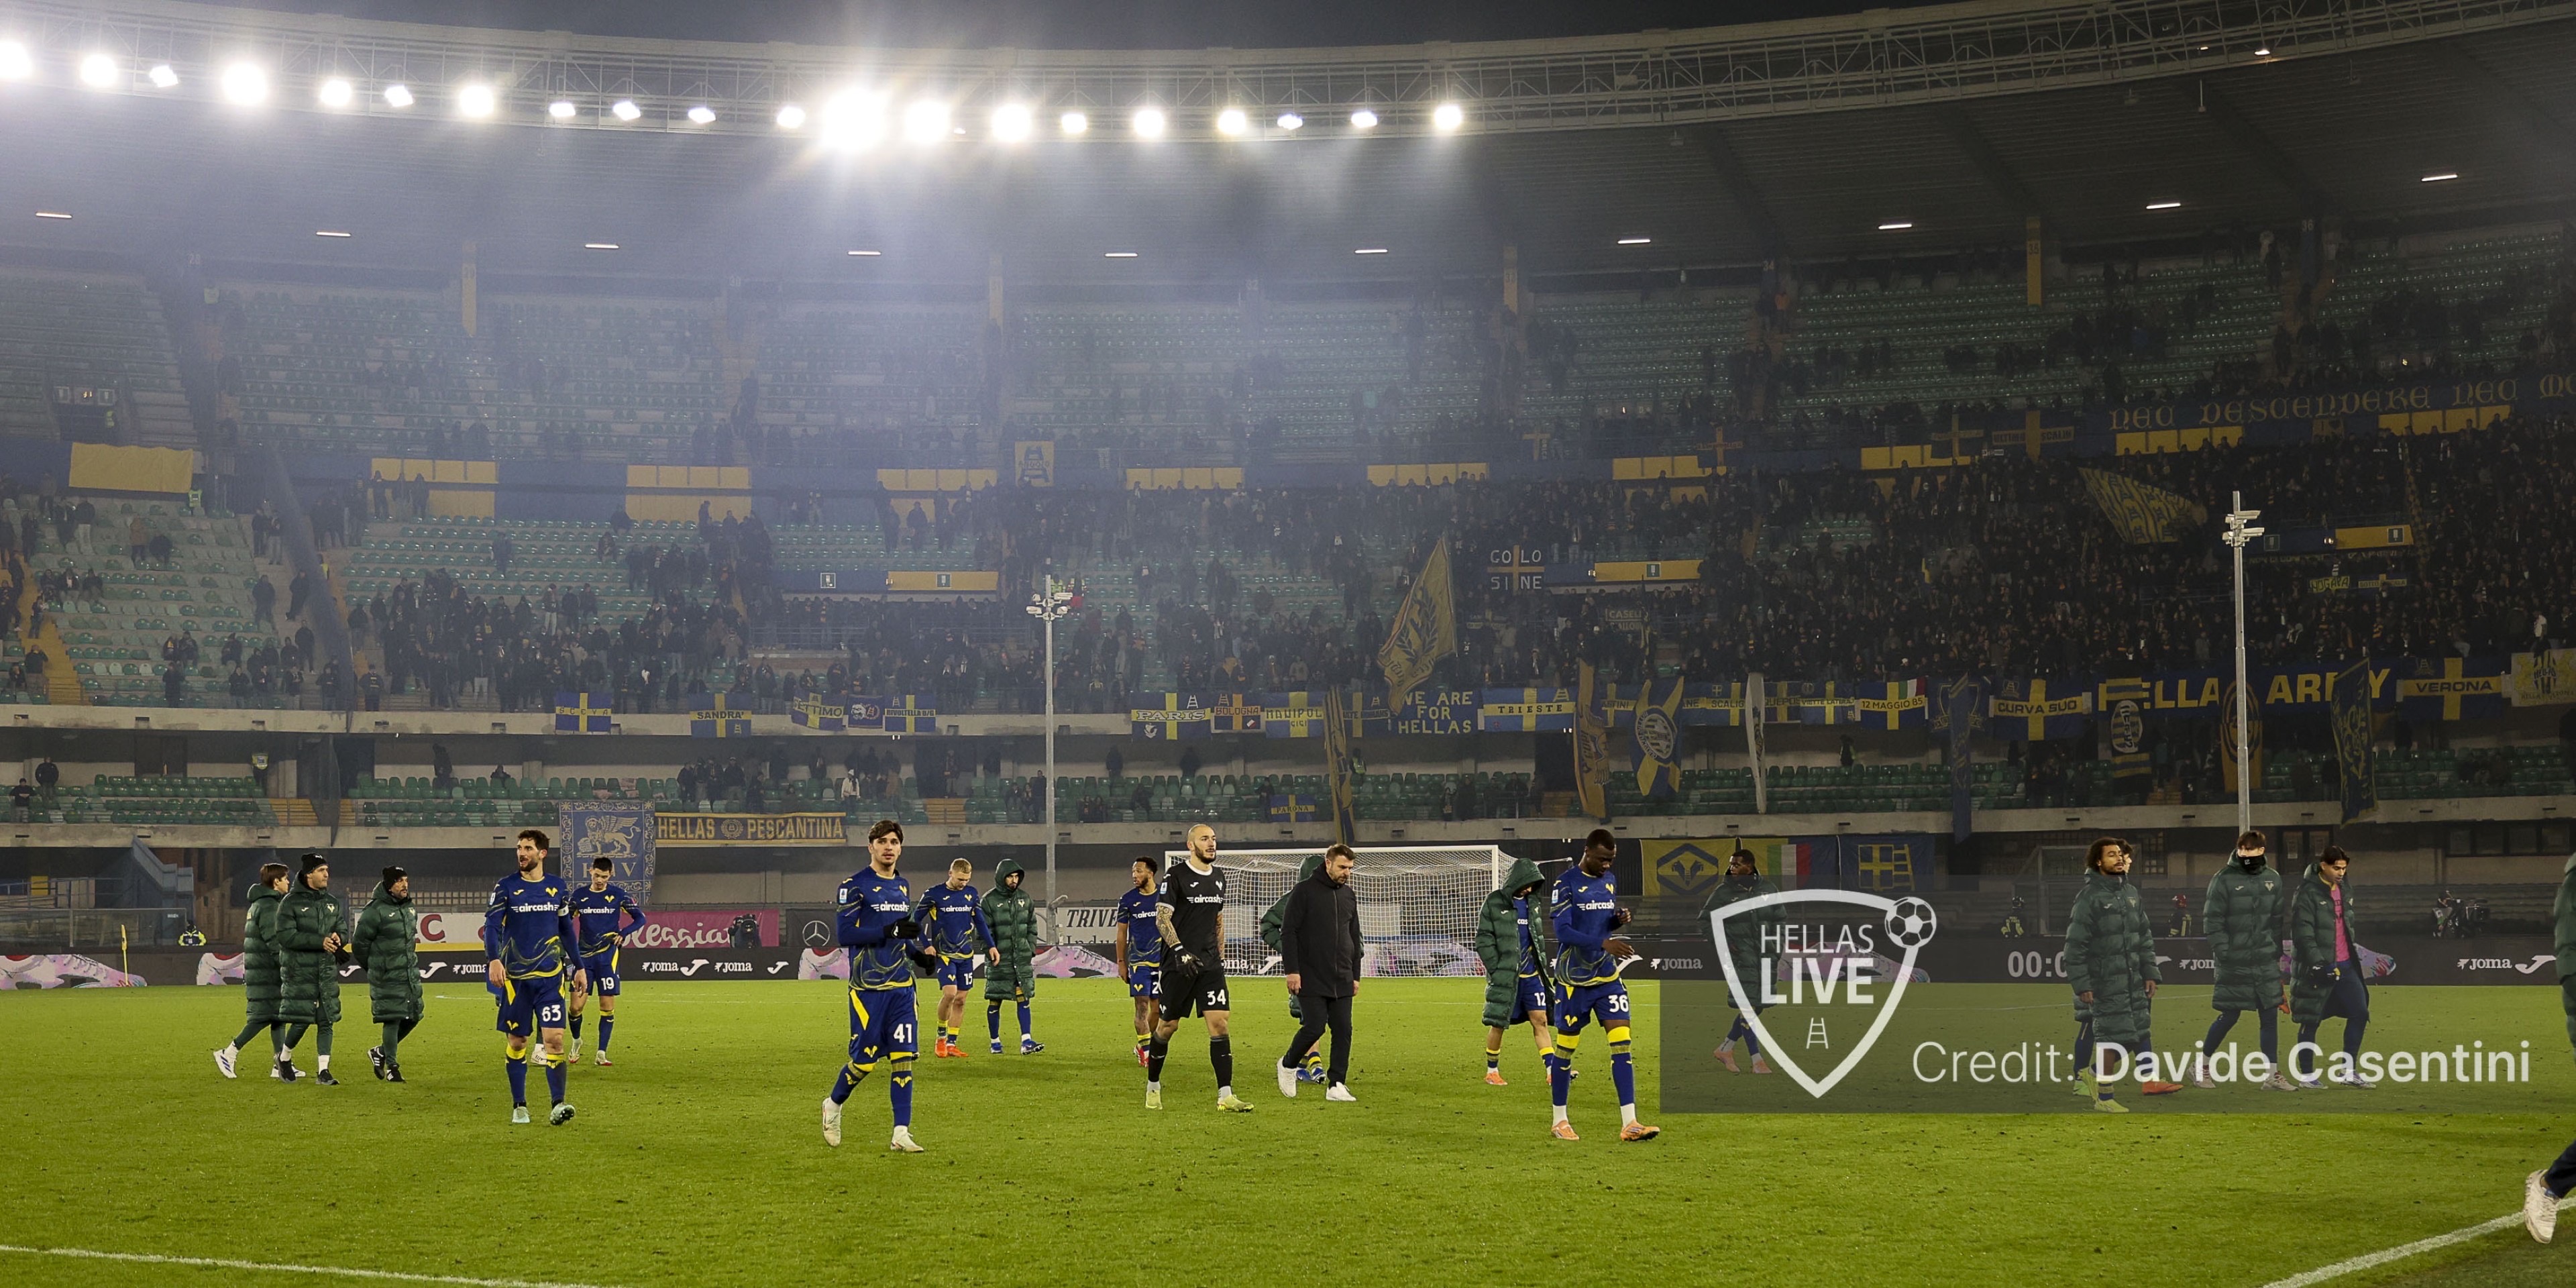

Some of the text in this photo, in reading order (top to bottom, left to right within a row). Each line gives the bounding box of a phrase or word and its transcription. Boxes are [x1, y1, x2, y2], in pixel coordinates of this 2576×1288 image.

[2416, 680, 2493, 693] VERONA
[1437, 690, 1474, 706] ARE
[1862, 698, 1923, 709] 12 MAGGIO 85
[1216, 706, 1259, 715] BOLOGNA
[1417, 706, 1451, 720] FOR
[1498, 704, 1563, 714] TRIESTE
[1997, 700, 2077, 714] CURVA SUD
[1136, 710, 1205, 721] PARIS
[1398, 720, 1472, 735] HELLAS
[1276, 804, 1309, 814] PARONA
[657, 816, 842, 840] HELLAS PESCANTINA
[1194, 894, 1221, 904] aircash
[1585, 900, 1615, 910] aircash
[519, 902, 555, 913] aircash
[582, 906, 610, 914] aircash
[880, 900, 908, 912] aircash
[945, 904, 970, 913] aircash
[601, 977, 614, 990] 19
[964, 973, 973, 985] 15
[1207, 989, 1226, 1006] 34
[1534, 992, 1546, 1006] 12
[1608, 994, 1629, 1012] 36
[541, 1004, 561, 1022] 63
[894, 1024, 912, 1043] 41
